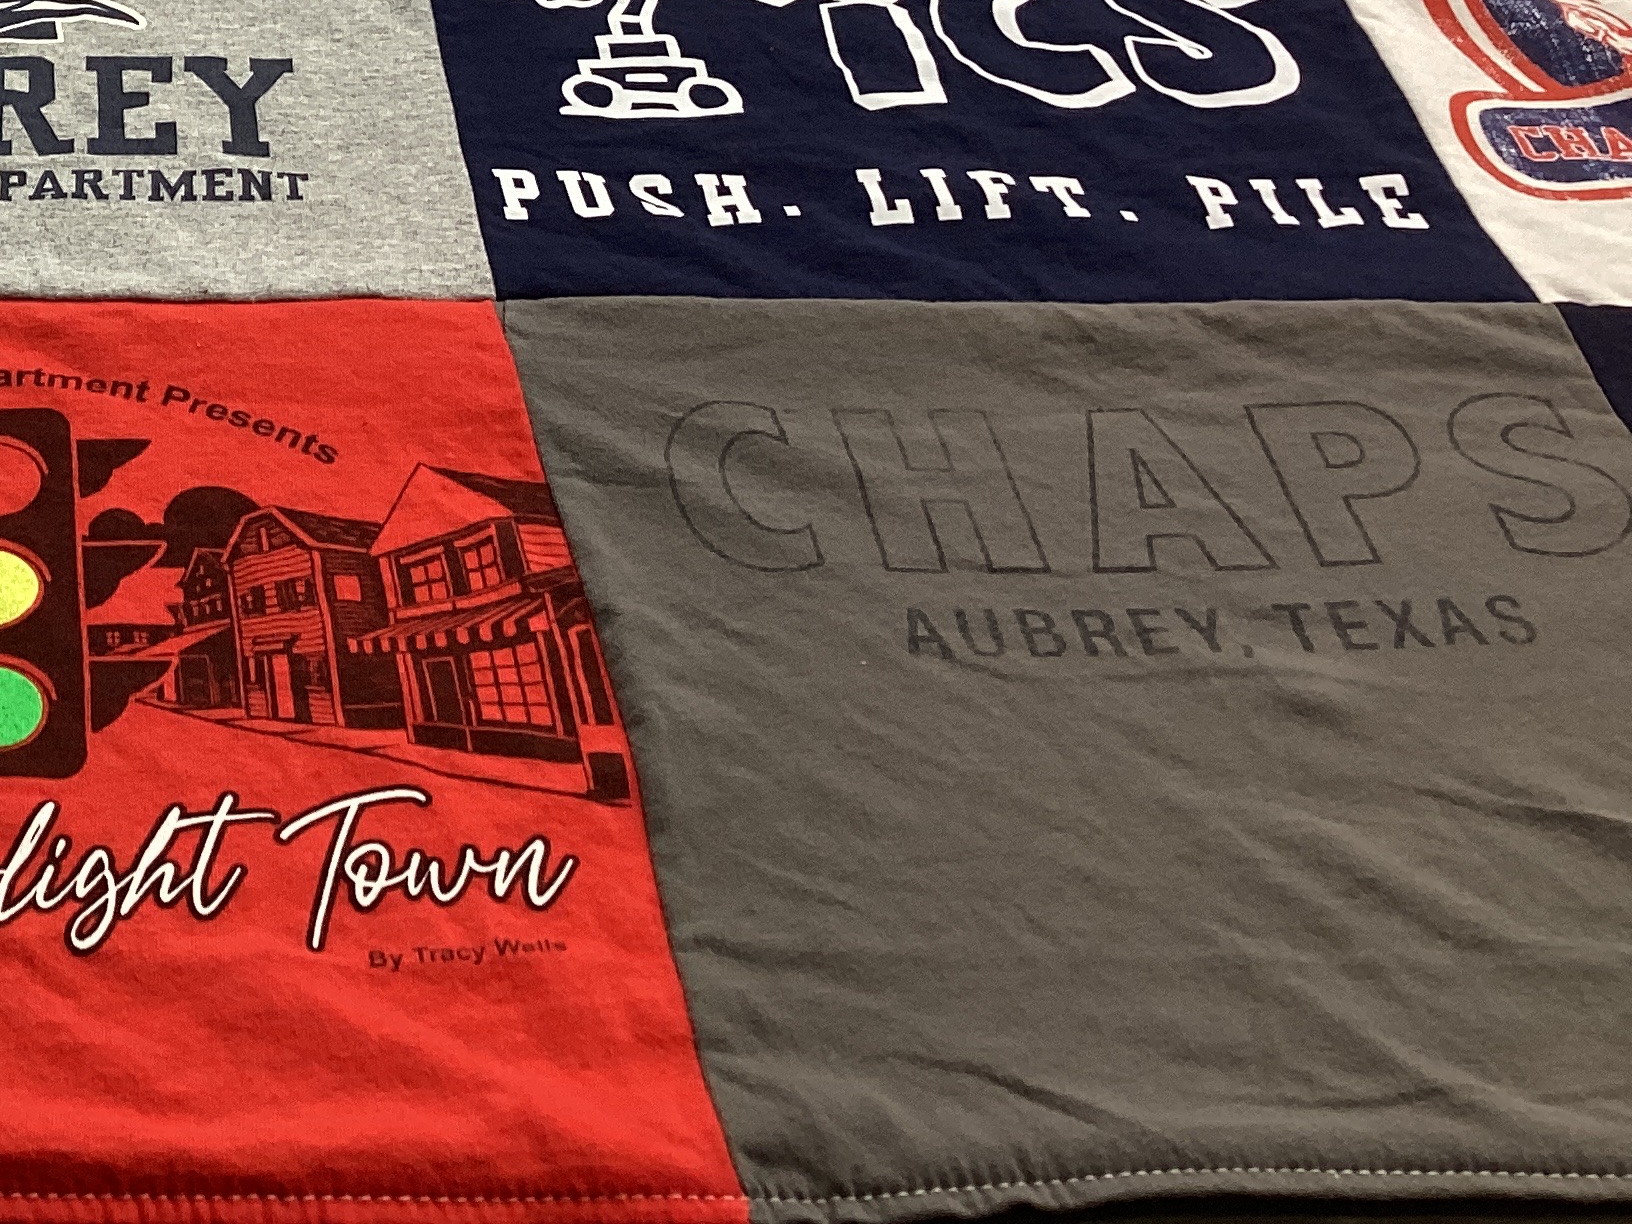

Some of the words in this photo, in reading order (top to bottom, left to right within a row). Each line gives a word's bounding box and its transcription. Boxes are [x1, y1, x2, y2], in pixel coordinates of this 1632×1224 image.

[492, 167, 804, 228] PUSH.
[854, 168, 1141, 228] LIFT.
[1184, 173, 1432, 231] PILE
[160, 383, 341, 466] Presents
[664, 391, 1632, 575] CHAPS
[904, 601, 1256, 660] AUBREY,
[1272, 592, 1540, 655] TEXAS
[273, 785, 578, 954] Town
[368, 949, 404, 973] By
[412, 945, 487, 966] Tracy
